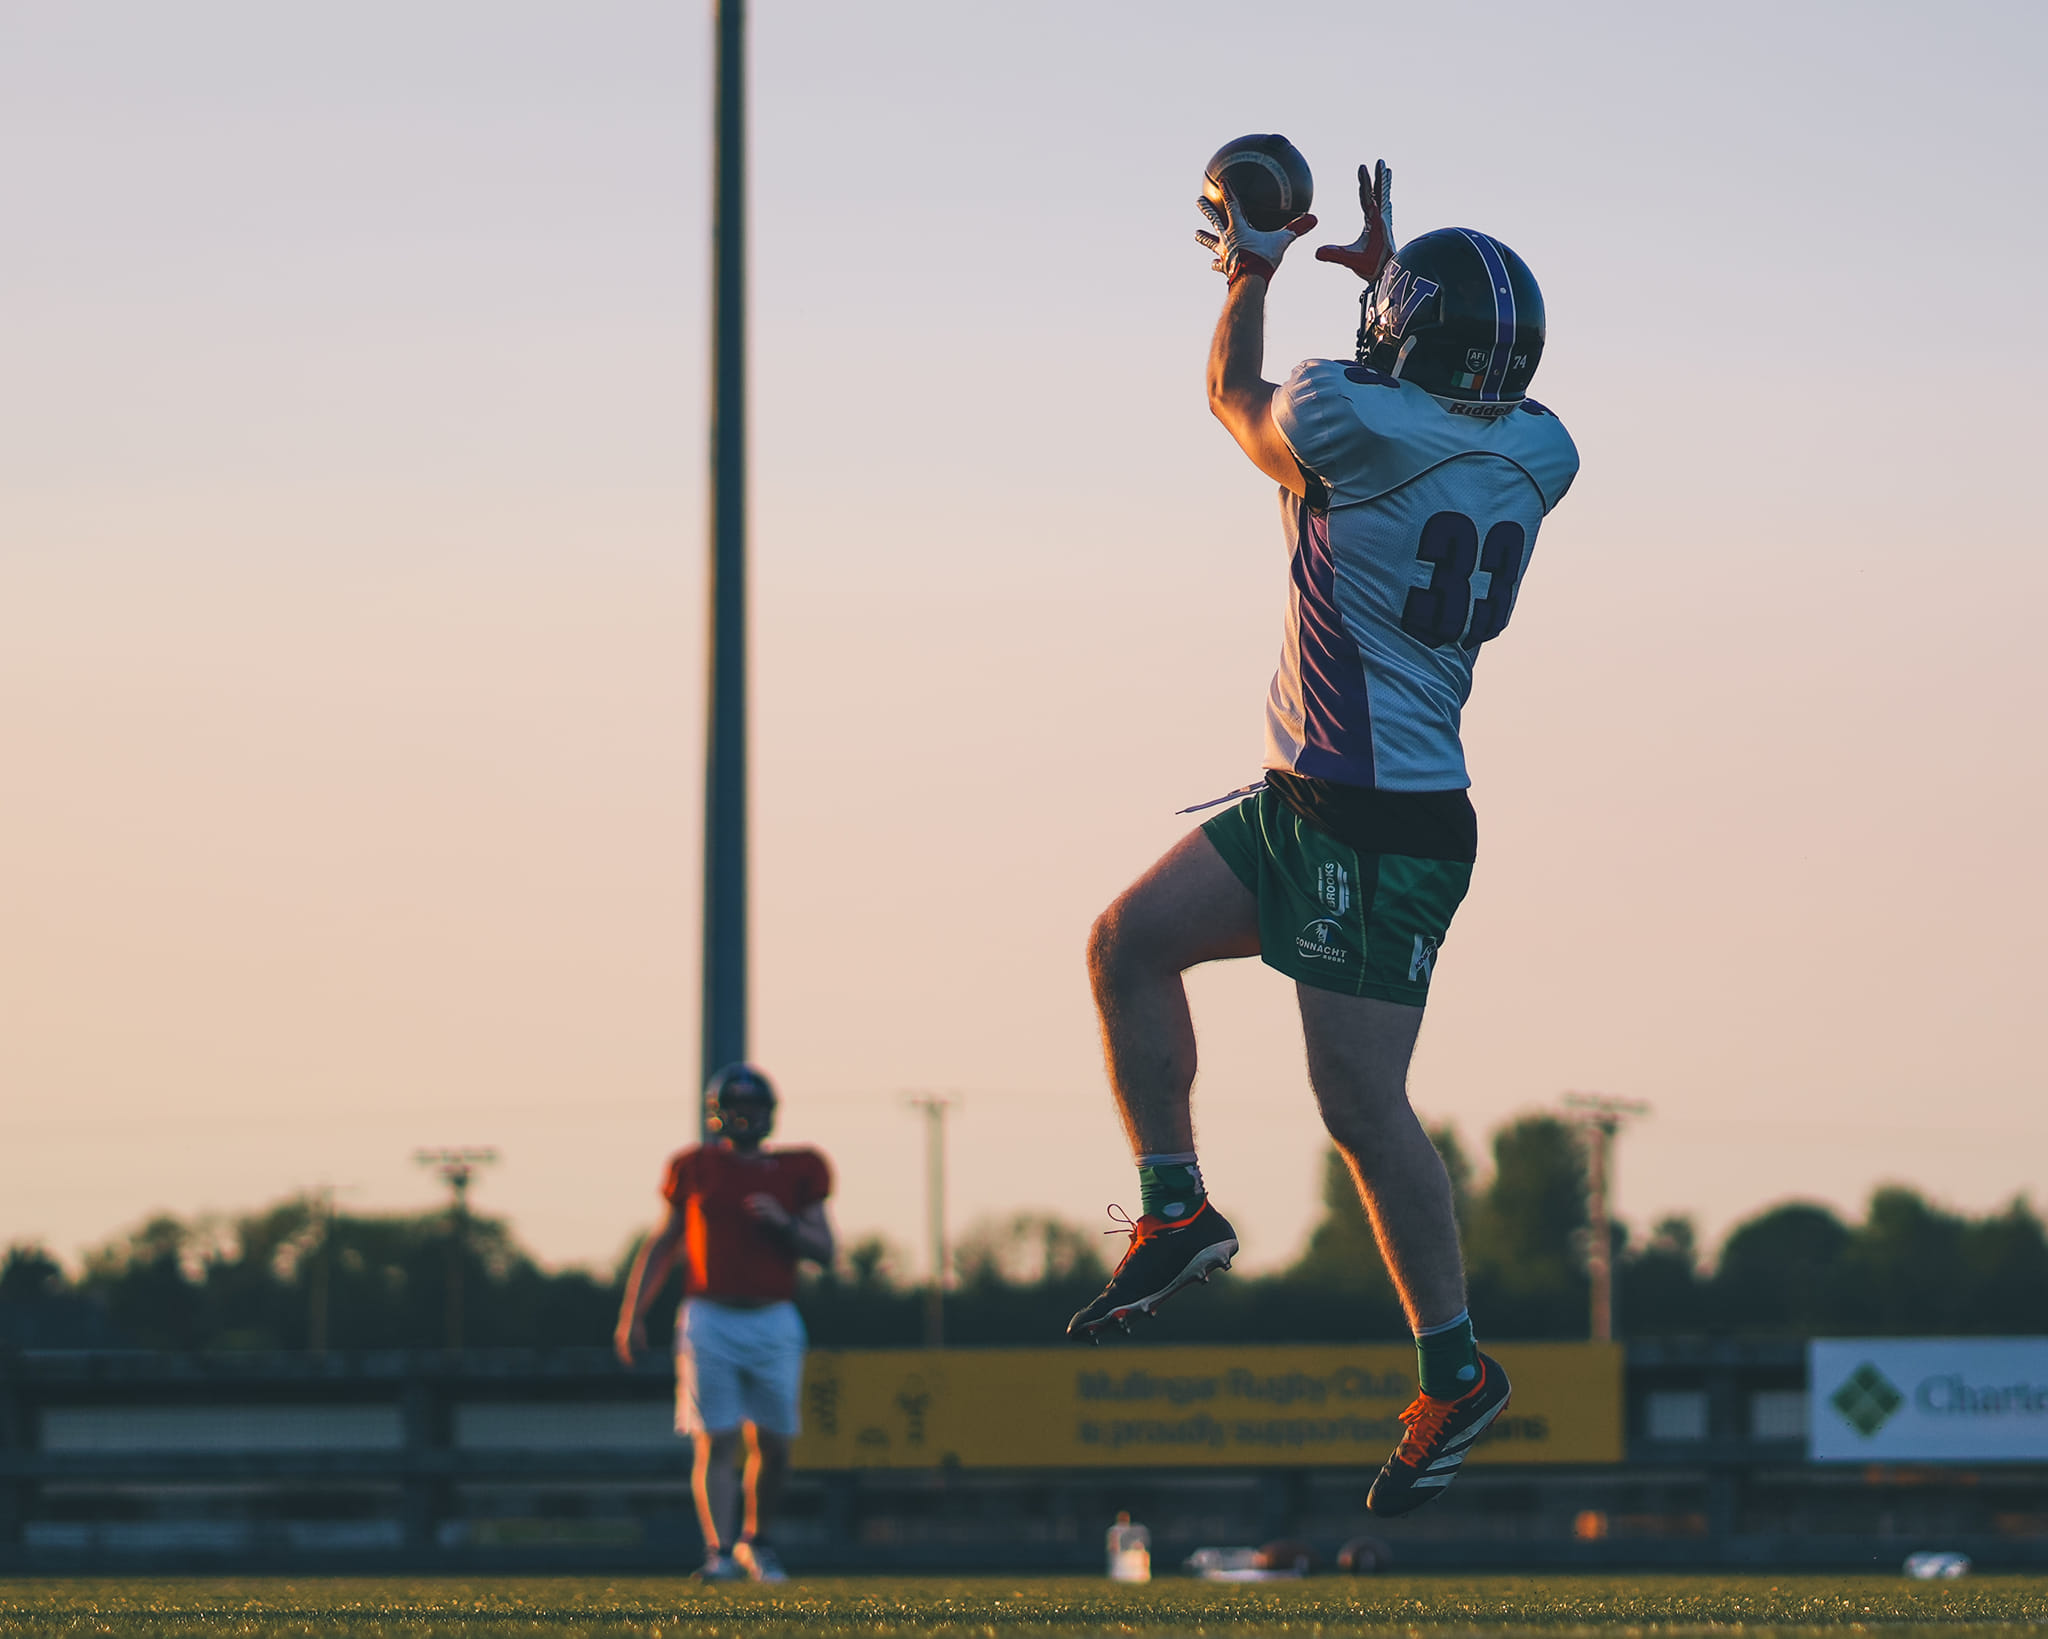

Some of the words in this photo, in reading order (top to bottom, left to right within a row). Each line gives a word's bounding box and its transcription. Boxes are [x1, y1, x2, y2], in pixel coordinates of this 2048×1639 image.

[1376, 260, 1439, 339] W
[1470, 351, 1485, 361] AFI
[1512, 355, 1527, 369] 74
[1401, 510, 1525, 650] 33
[1325, 862, 1336, 909] BROOKS
[1296, 936, 1348, 958] CONNACHT
[1227, 1368, 1326, 1405] Rugby
